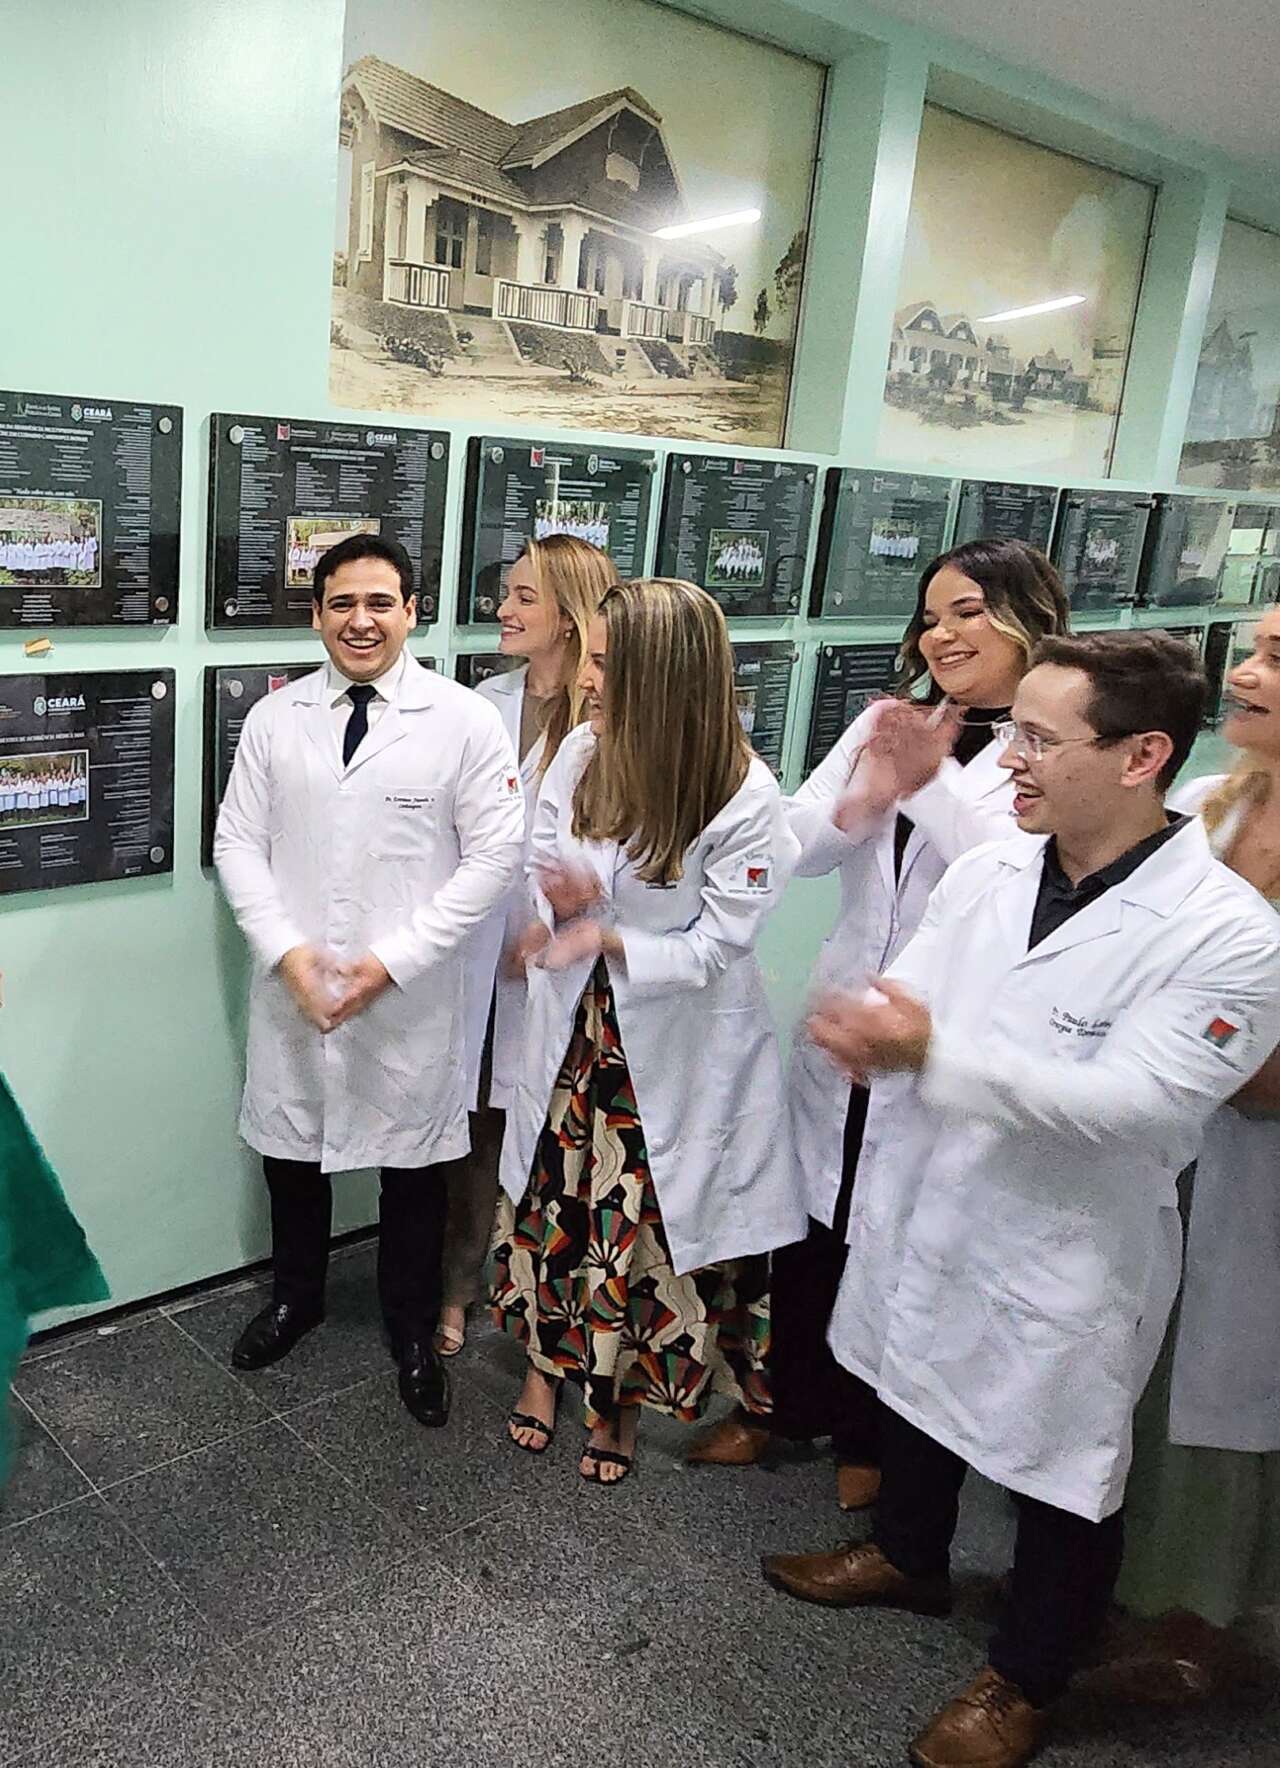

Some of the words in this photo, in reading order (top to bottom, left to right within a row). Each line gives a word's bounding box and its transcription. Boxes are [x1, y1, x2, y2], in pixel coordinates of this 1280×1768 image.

[83, 407, 112, 417] CEARÁ
[374, 432, 398, 442] CEARÁ
[48, 693, 86, 708] CEARÁ
